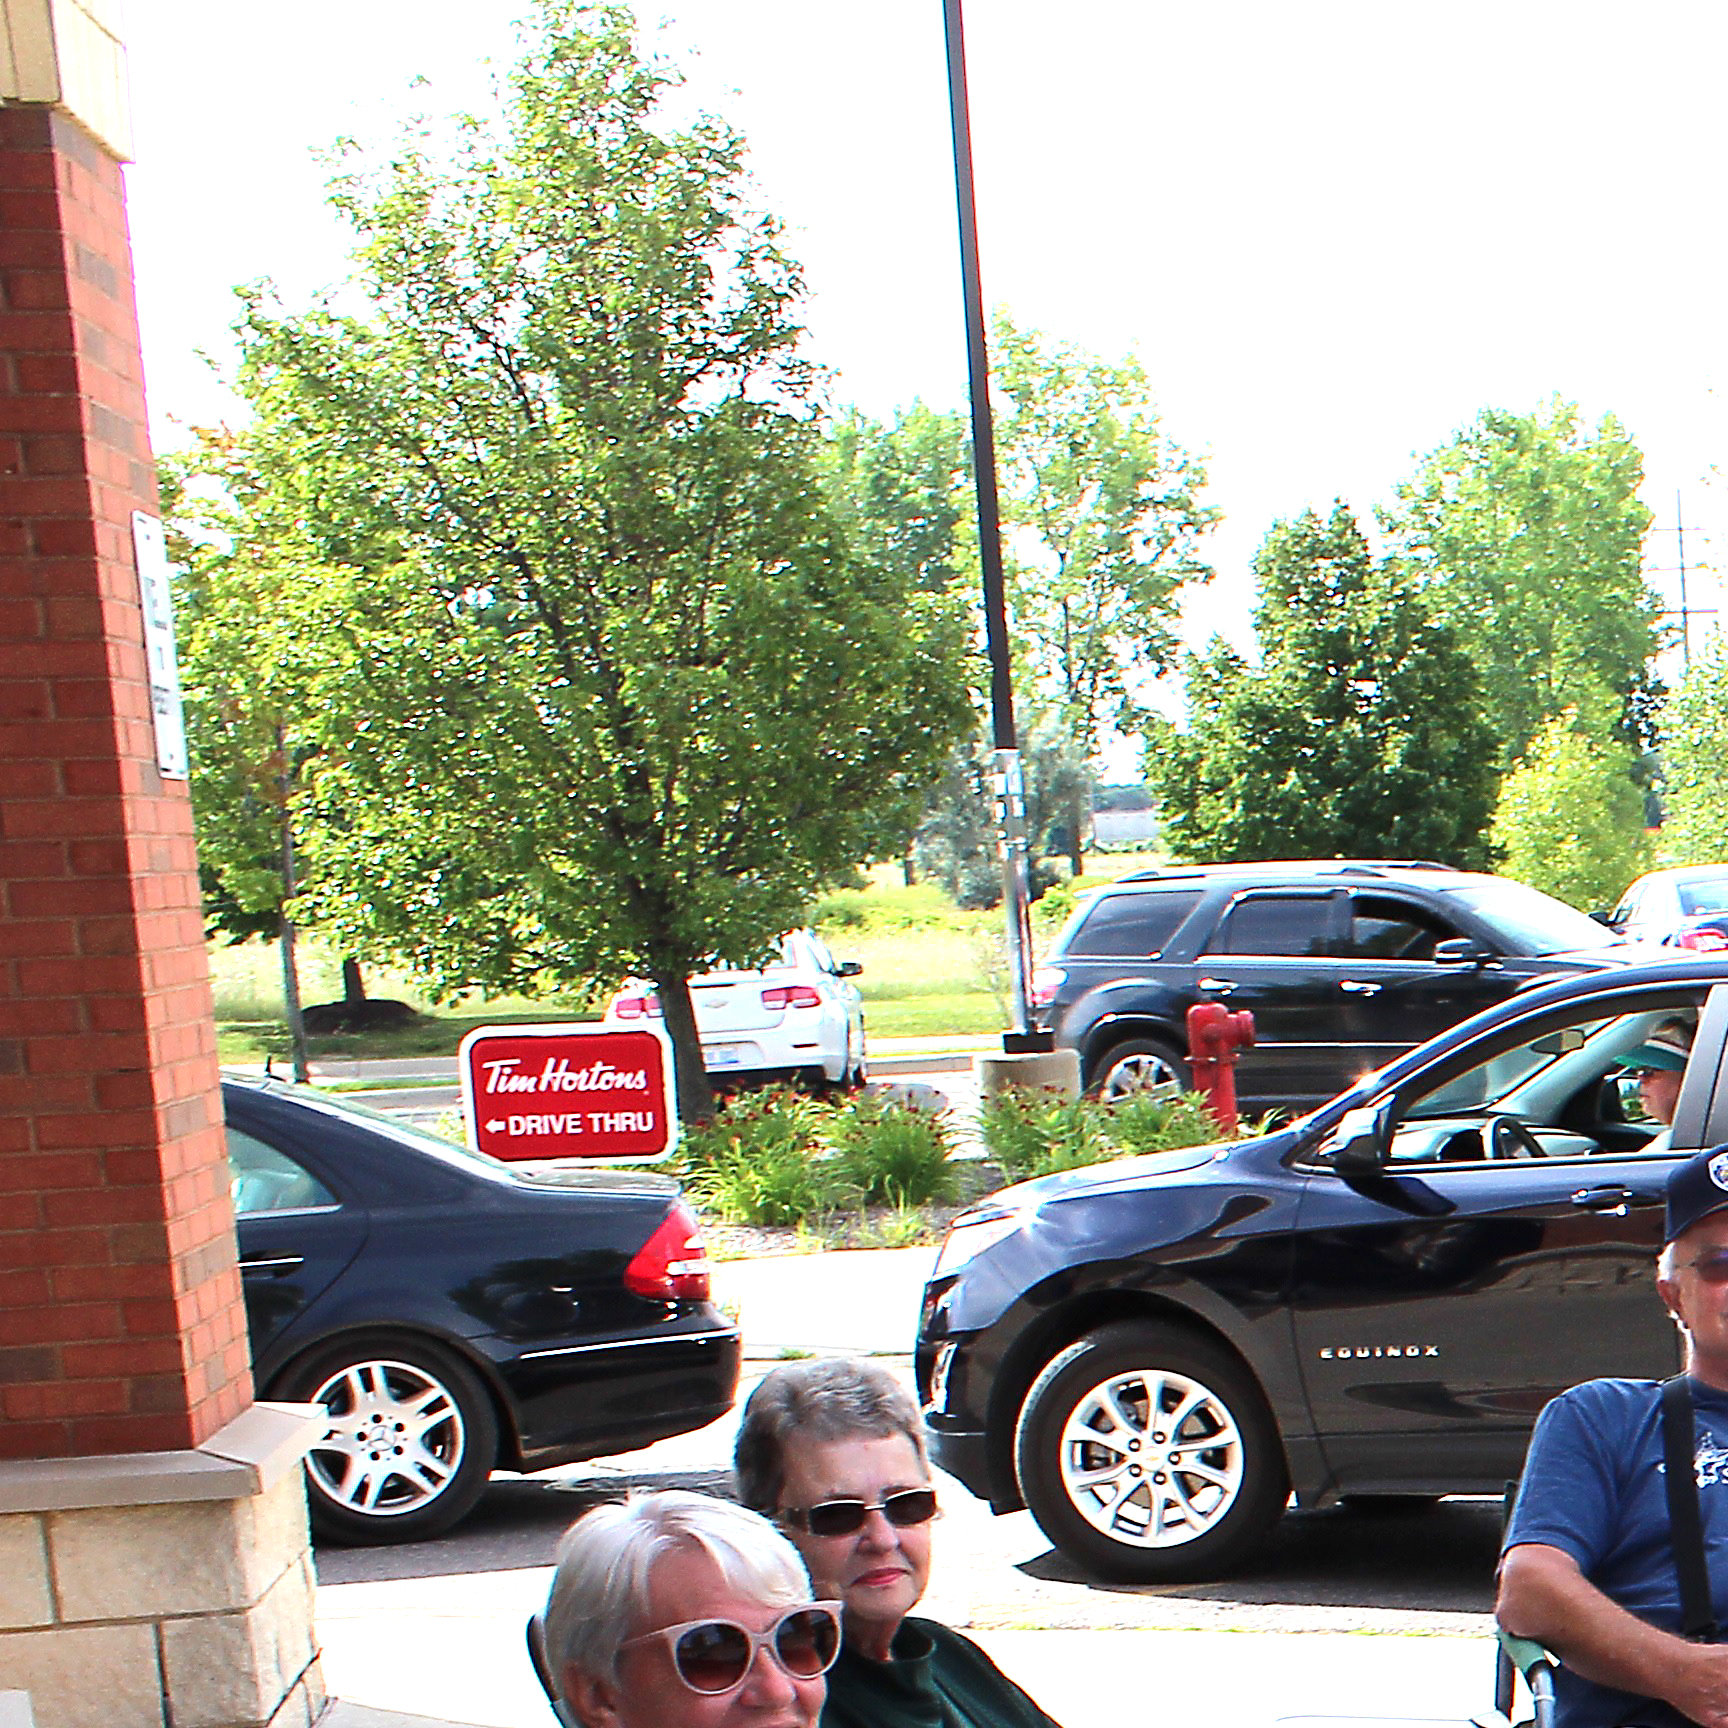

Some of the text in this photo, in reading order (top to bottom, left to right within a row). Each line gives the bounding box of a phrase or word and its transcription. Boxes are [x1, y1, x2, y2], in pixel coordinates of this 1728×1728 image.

[482, 1057, 647, 1094] Tim Hortons
[508, 1111, 654, 1136] DRIVE THRU
[1319, 1344, 1440, 1360] EQUINOX
